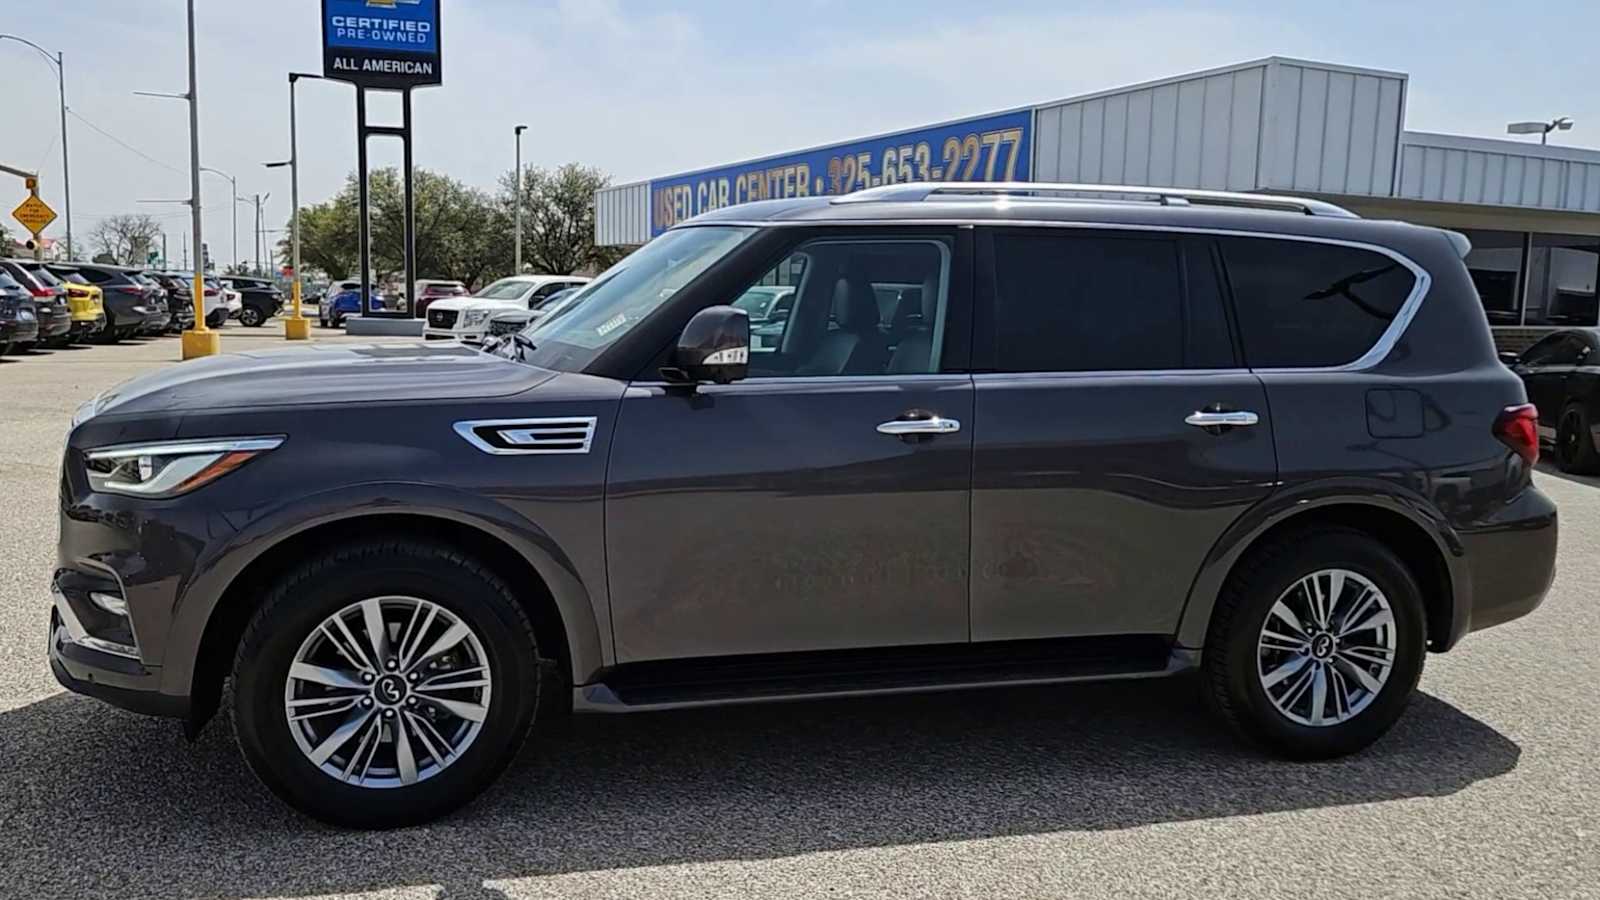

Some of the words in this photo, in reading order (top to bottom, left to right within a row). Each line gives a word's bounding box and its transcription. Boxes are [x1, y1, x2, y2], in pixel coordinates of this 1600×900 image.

[332, 16, 430, 31] CERTIFIED
[337, 28, 426, 43] PRE-OWNED
[333, 57, 359, 70] ALL
[362, 59, 433, 74] AMERICAN
[654, 185, 691, 227] USED
[697, 178, 730, 211] CAR
[735, 164, 809, 202] CENTER
[828, 128, 1023, 193] 325-653-2277
